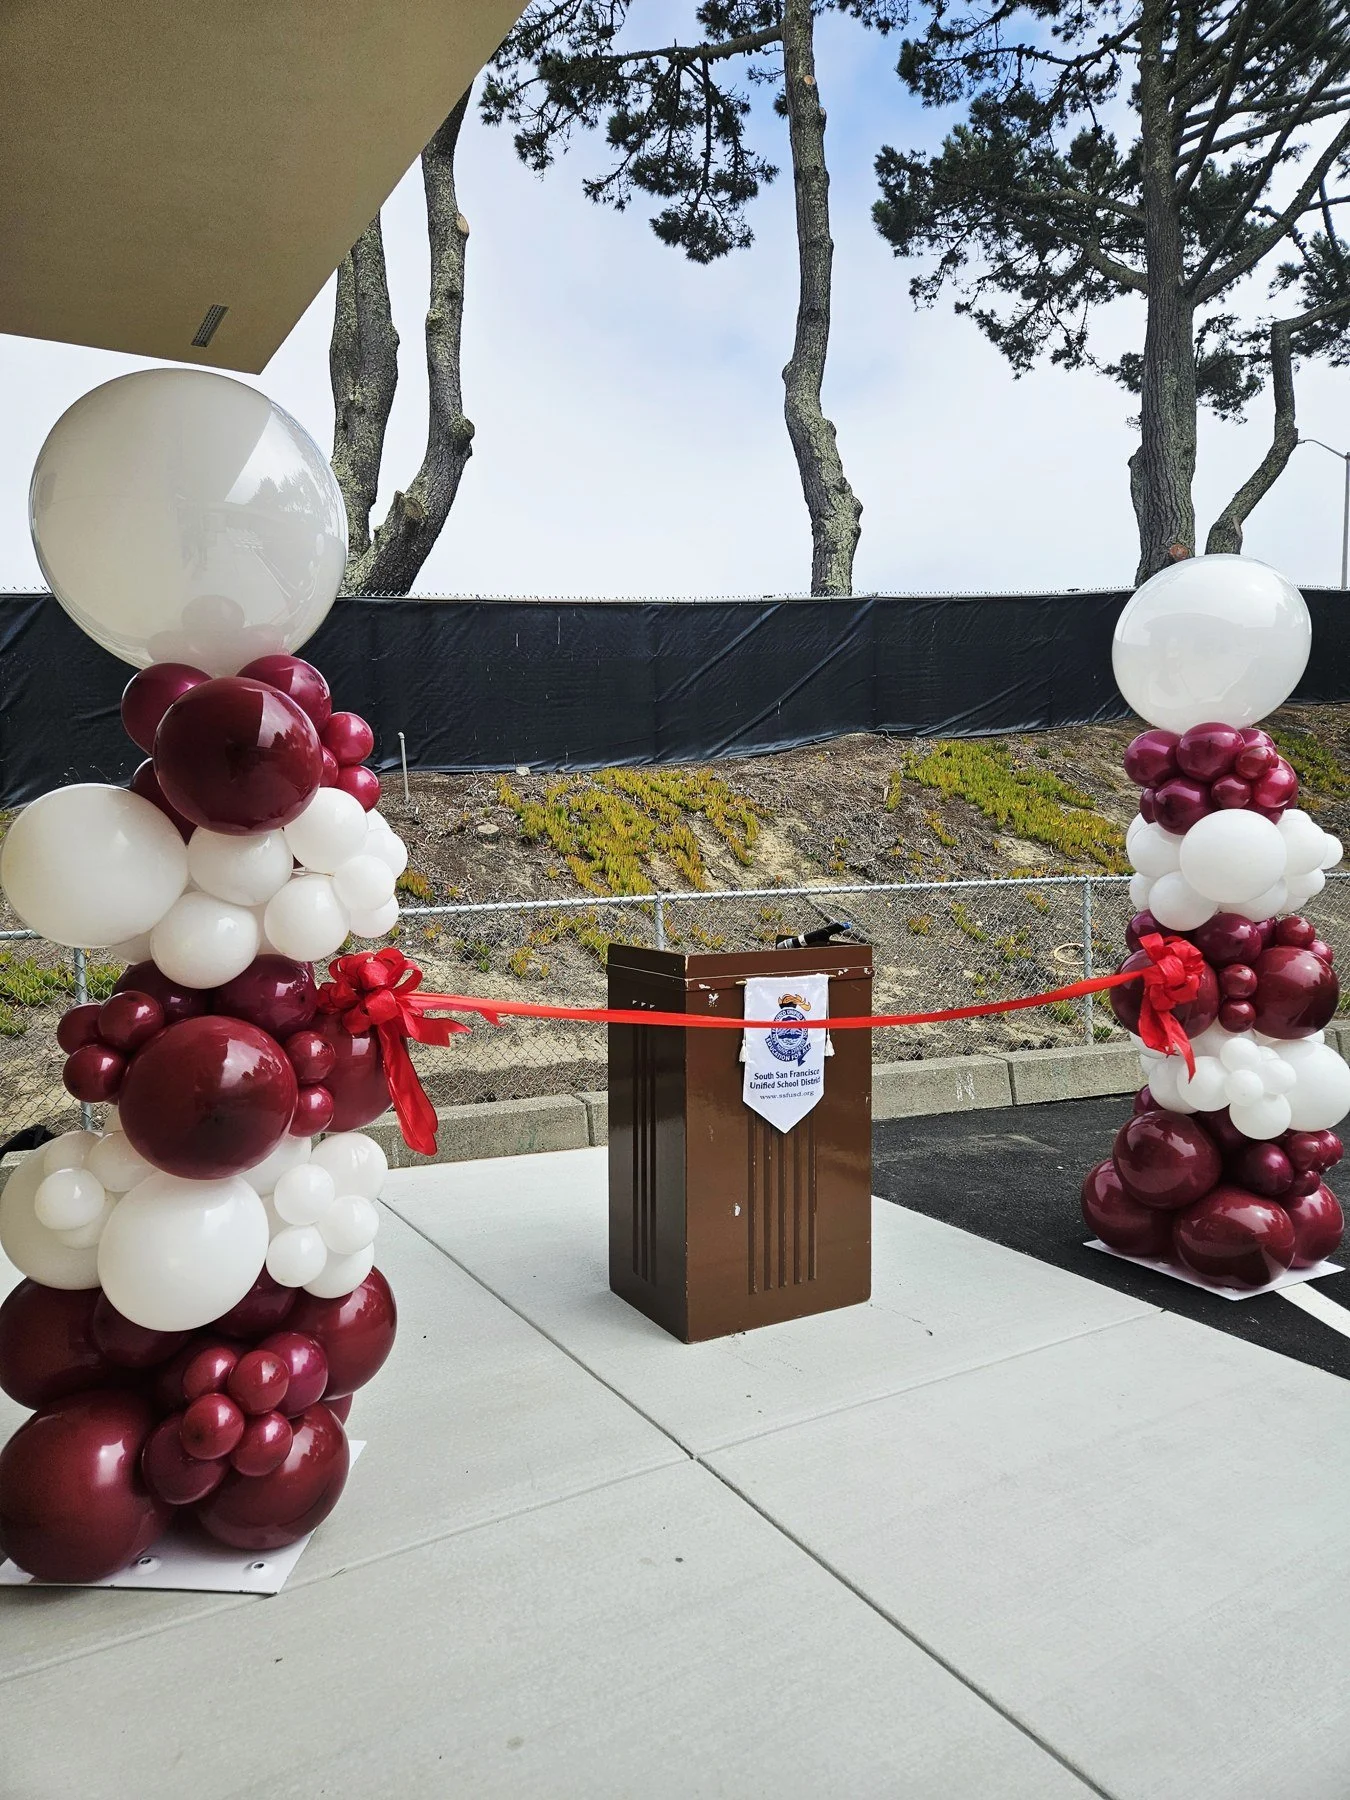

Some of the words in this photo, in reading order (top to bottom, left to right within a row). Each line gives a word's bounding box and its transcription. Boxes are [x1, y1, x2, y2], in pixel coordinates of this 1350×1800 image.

[765, 1037, 791, 1062] EDUCATION
[791, 1052, 802, 1062] FOR
[802, 1043, 812, 1054] ALL
[754, 1072, 774, 1080] South
[776, 1070, 788, 1078] San
[750, 1082, 776, 1090] Unified
[776, 1080, 798, 1088] School
[760, 1090, 814, 1100] www.ssfusd.org
